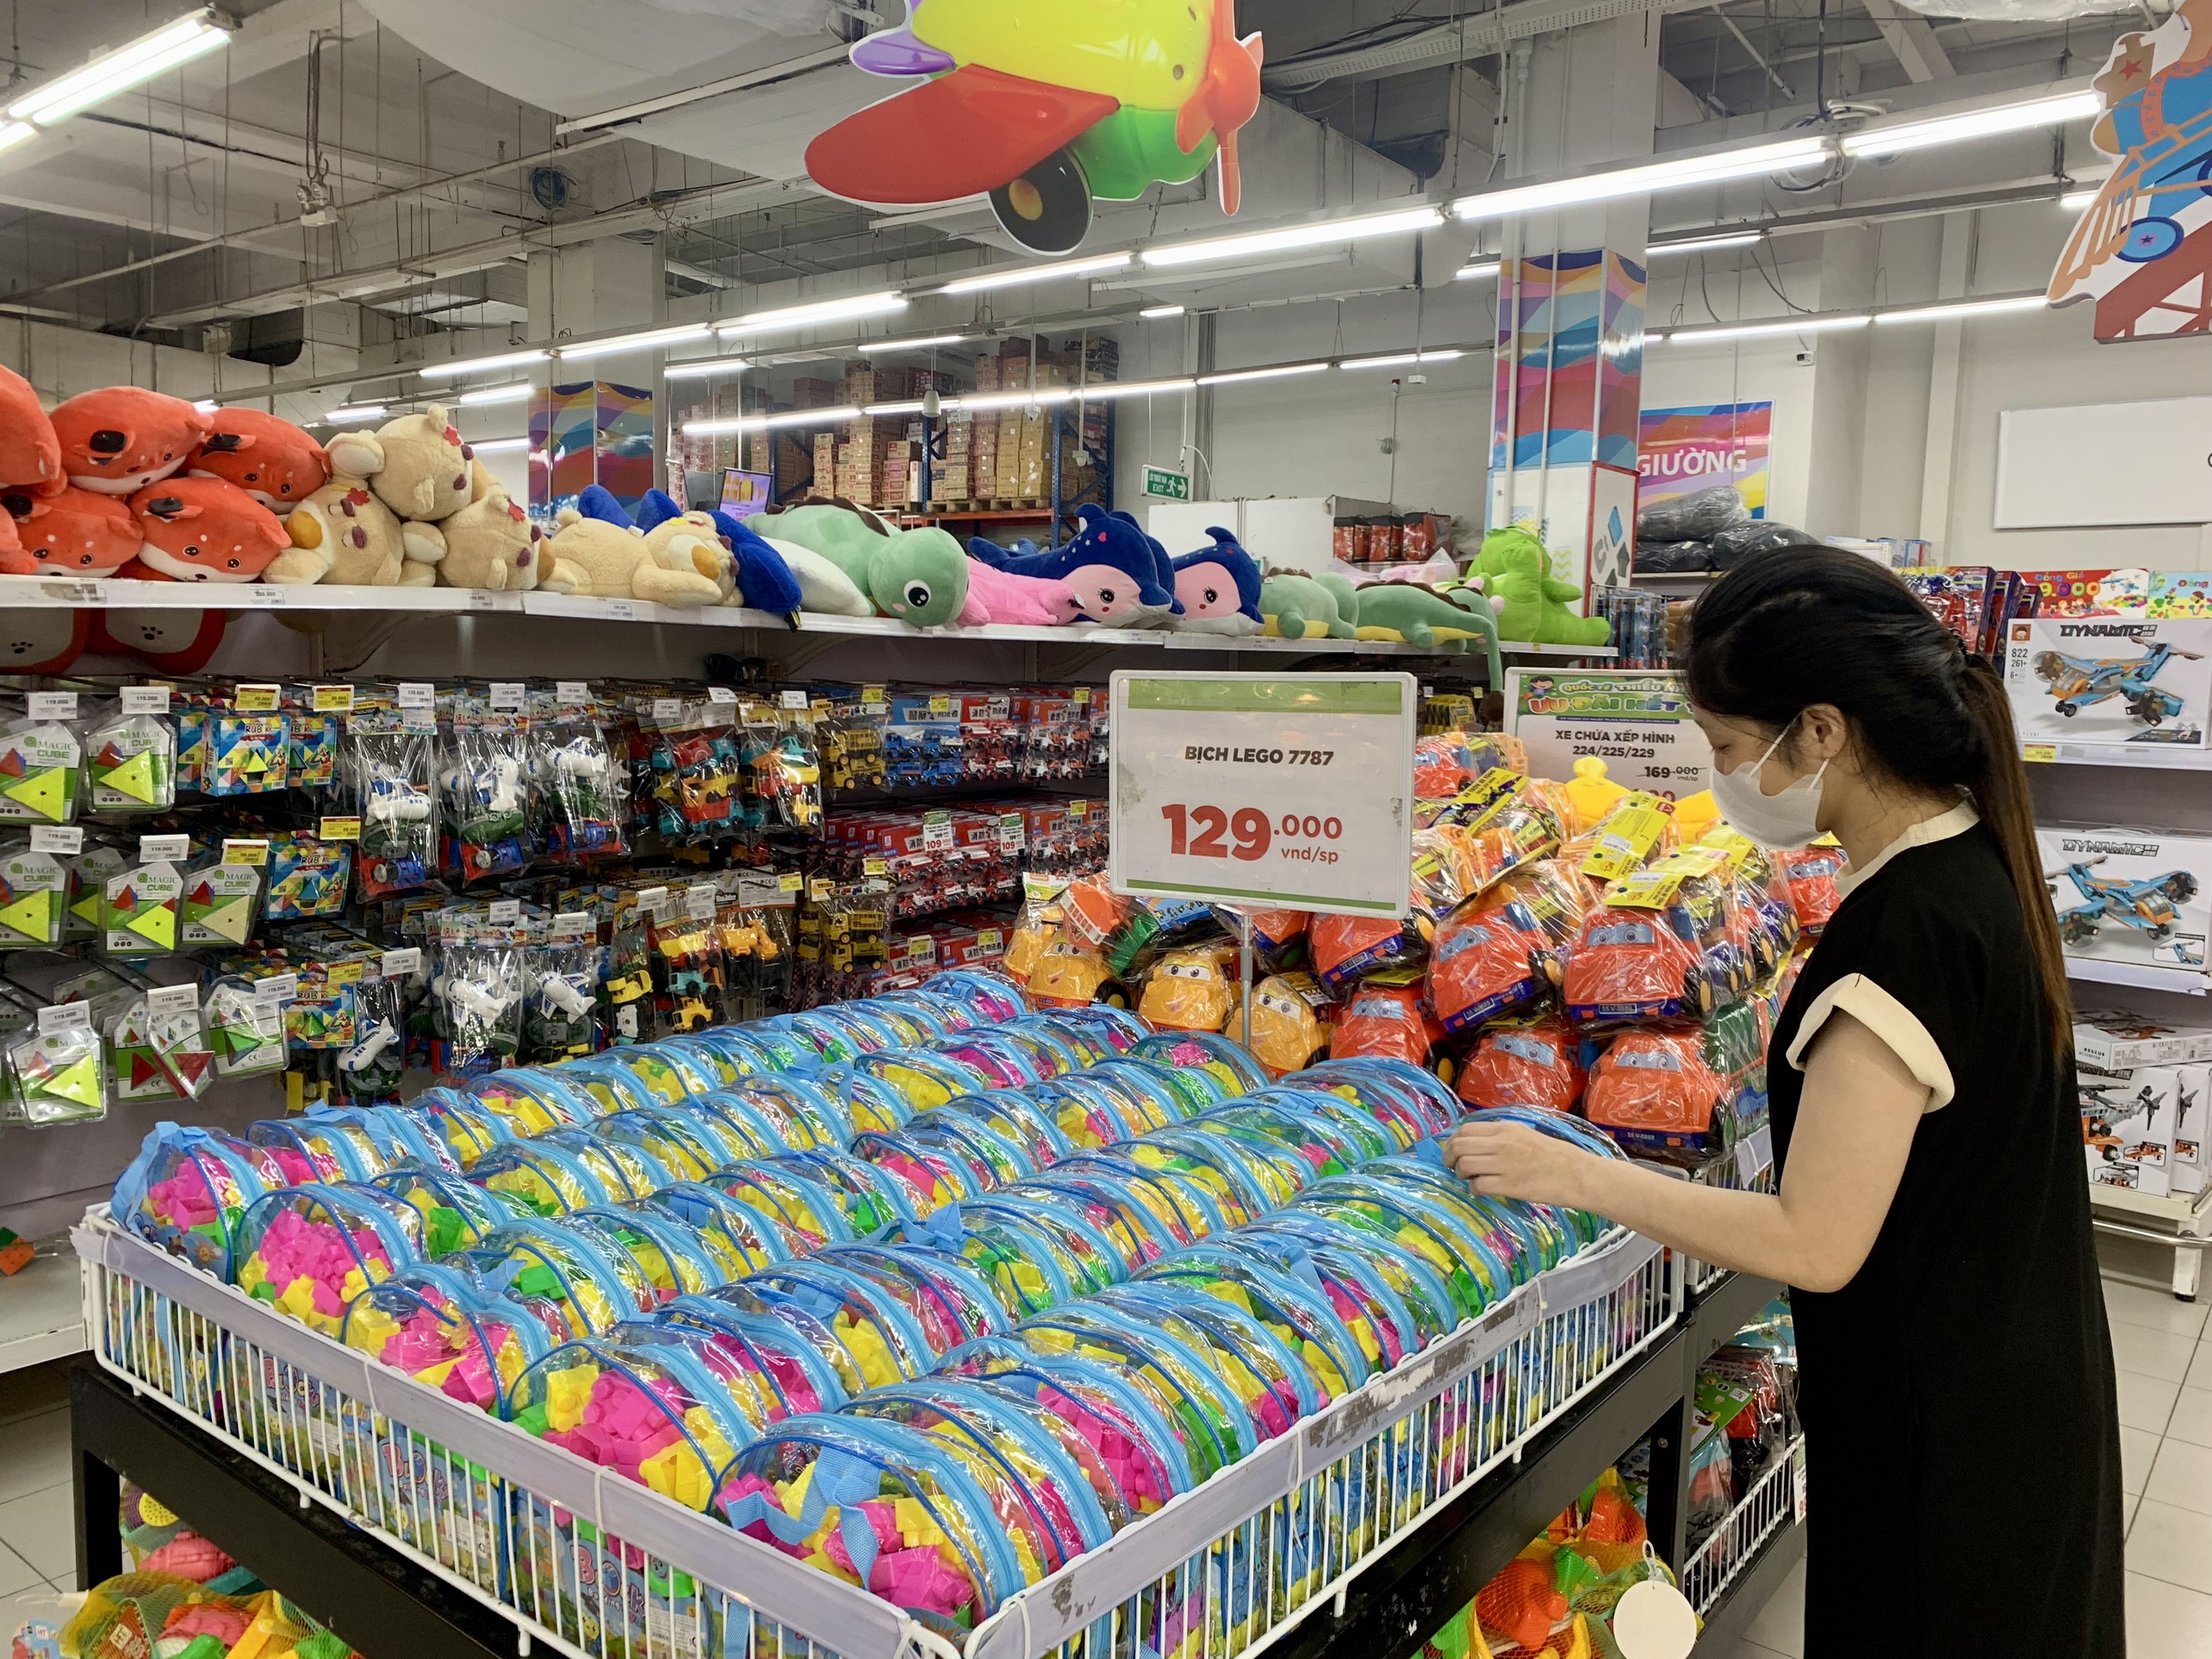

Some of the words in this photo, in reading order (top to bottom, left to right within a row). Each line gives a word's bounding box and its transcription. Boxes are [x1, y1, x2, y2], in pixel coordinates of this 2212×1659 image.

[1637, 447, 1747, 477] GIƯỜNG
[1153, 484, 1164, 493] EXIT
[2040, 581, 2101, 597] 9.000
[2060, 624, 2143, 637] DYNAMIC
[2011, 648, 2029, 657] 822
[2010, 659, 2028, 668] 261+
[1563, 681, 1594, 692] QUỐC
[1615, 678, 1661, 692] THIẾU
[1662, 681, 1686, 693] NH
[1529, 696, 1568, 713] ƯU
[1570, 693, 1620, 712] ĐÃI
[1625, 693, 1681, 712] HẾT
[130, 730, 162, 739] MAGIC
[1556, 730, 1572, 740] XE
[1575, 729, 1610, 742] CHỨA
[1613, 729, 1639, 743] XẾP
[1642, 730, 1675, 743] HÌNH
[38, 741, 75, 750] MAGIC
[1572, 745, 1656, 758] 224/225/229
[37, 749, 70, 759] CUBE
[1184, 746, 1229, 765] BỊCH
[1233, 748, 1283, 765] LEGO
[1289, 749, 1334, 766] 7787
[2062, 839, 2146, 855] DYNAMIC
[1281, 846, 1339, 865] vnd/sp
